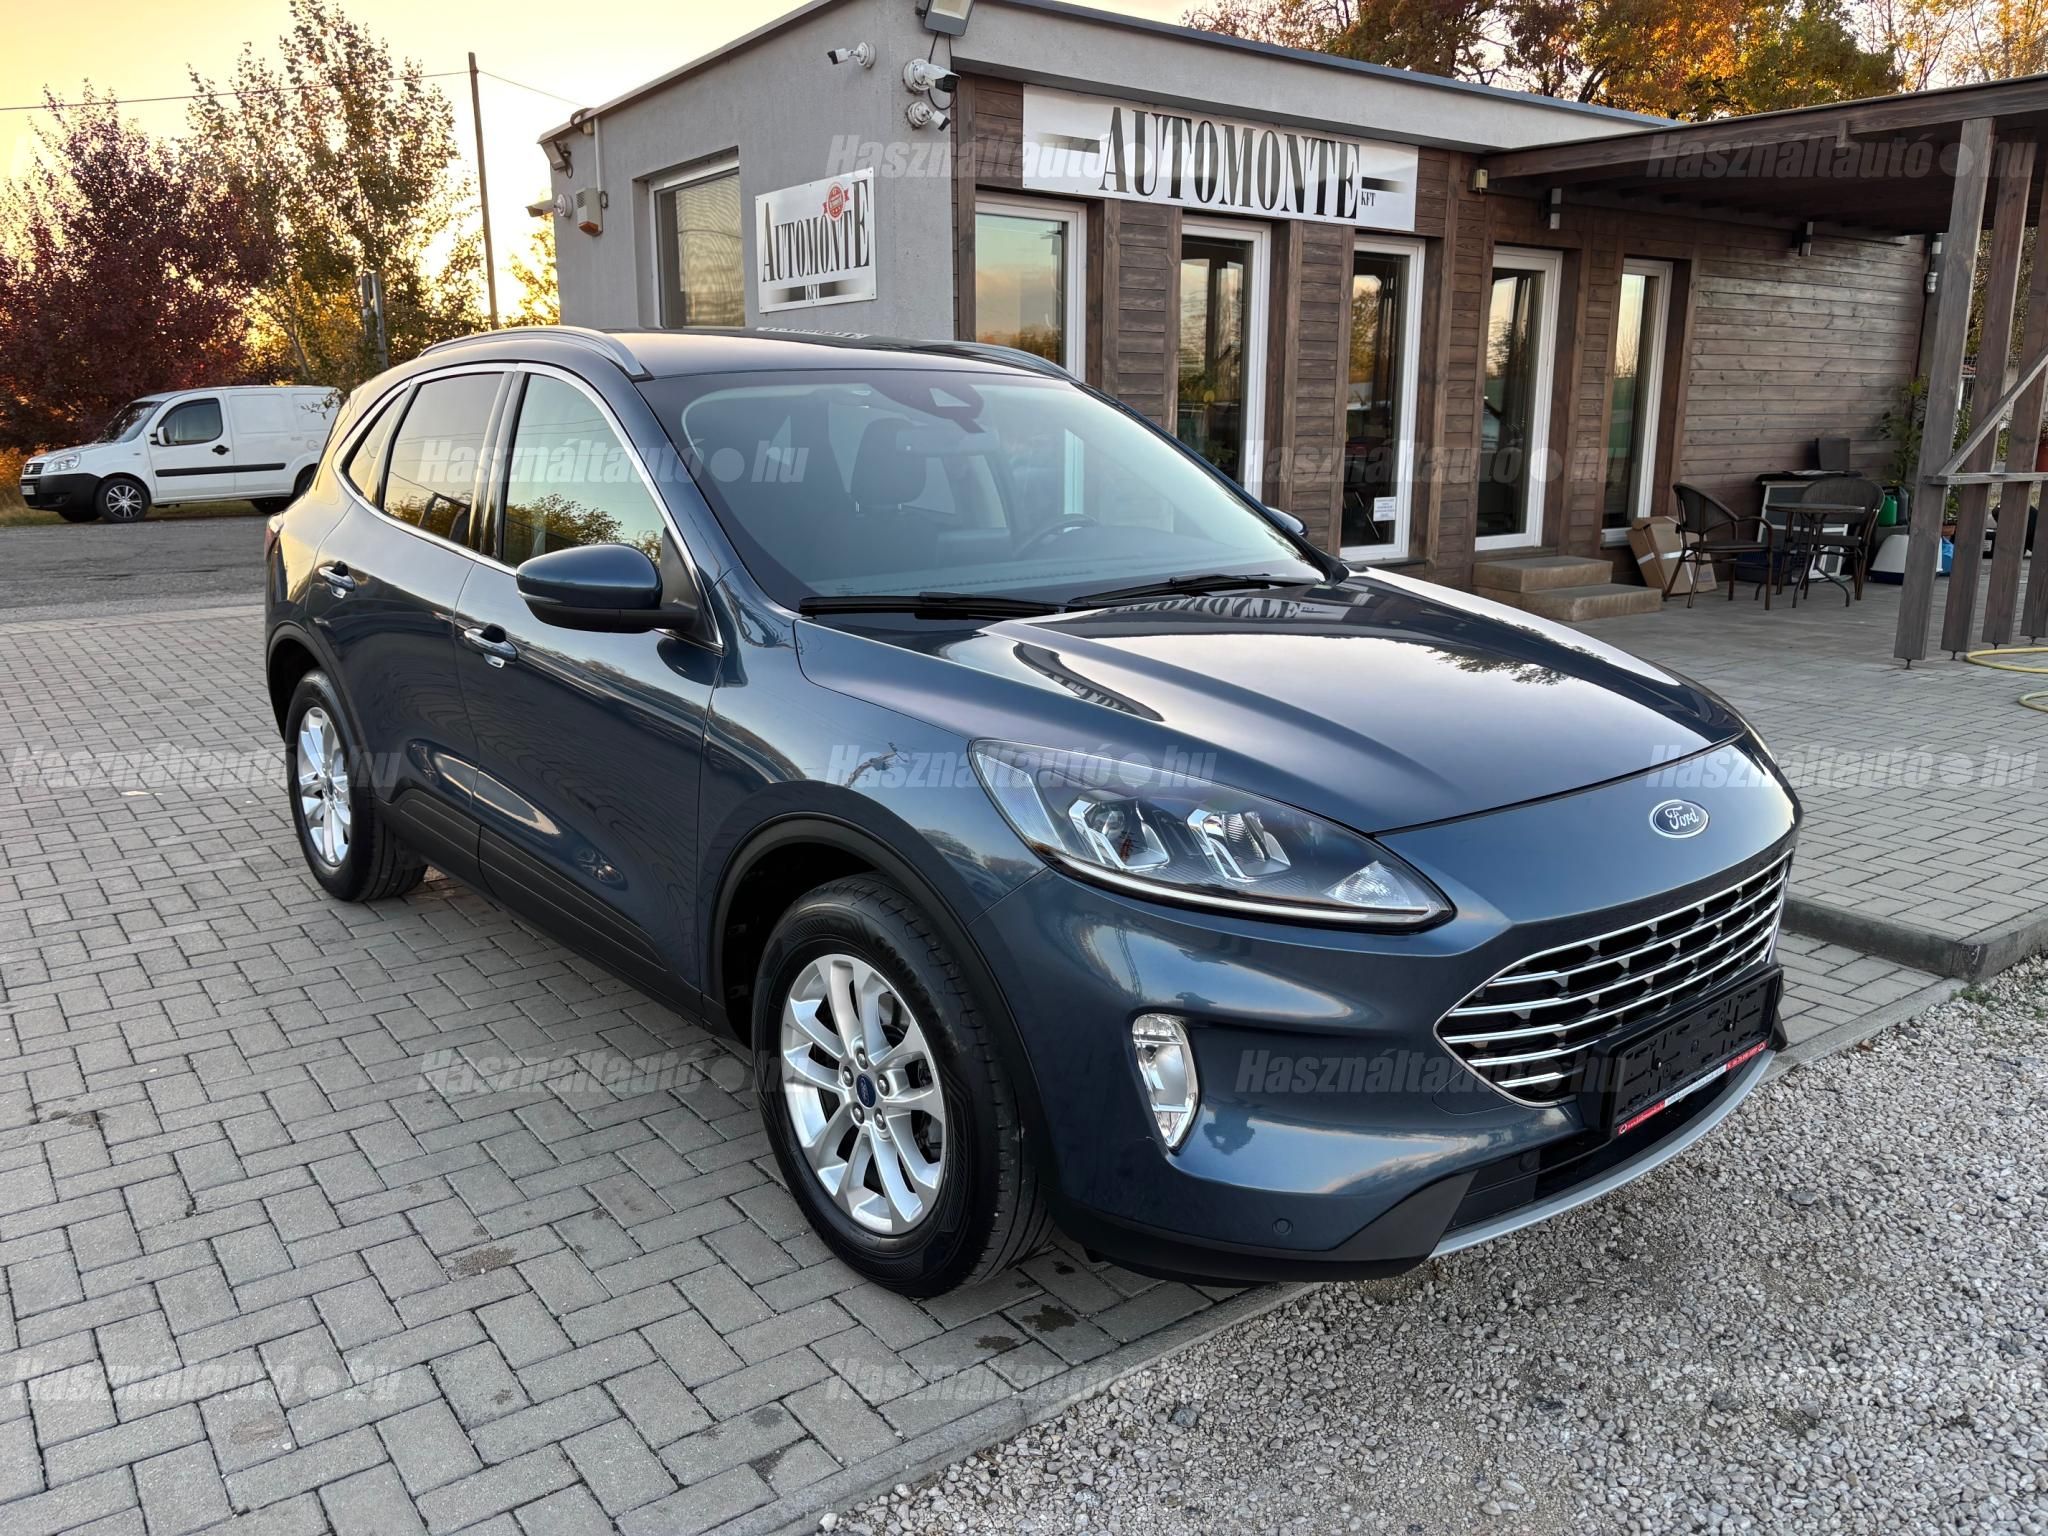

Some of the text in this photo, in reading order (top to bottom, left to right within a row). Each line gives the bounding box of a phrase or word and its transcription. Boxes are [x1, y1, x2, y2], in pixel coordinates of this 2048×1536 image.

[1098, 107, 1359, 219] AUTOMONTE
[1361, 191, 1376, 206] KFT
[1664, 805, 1700, 830] Ford
